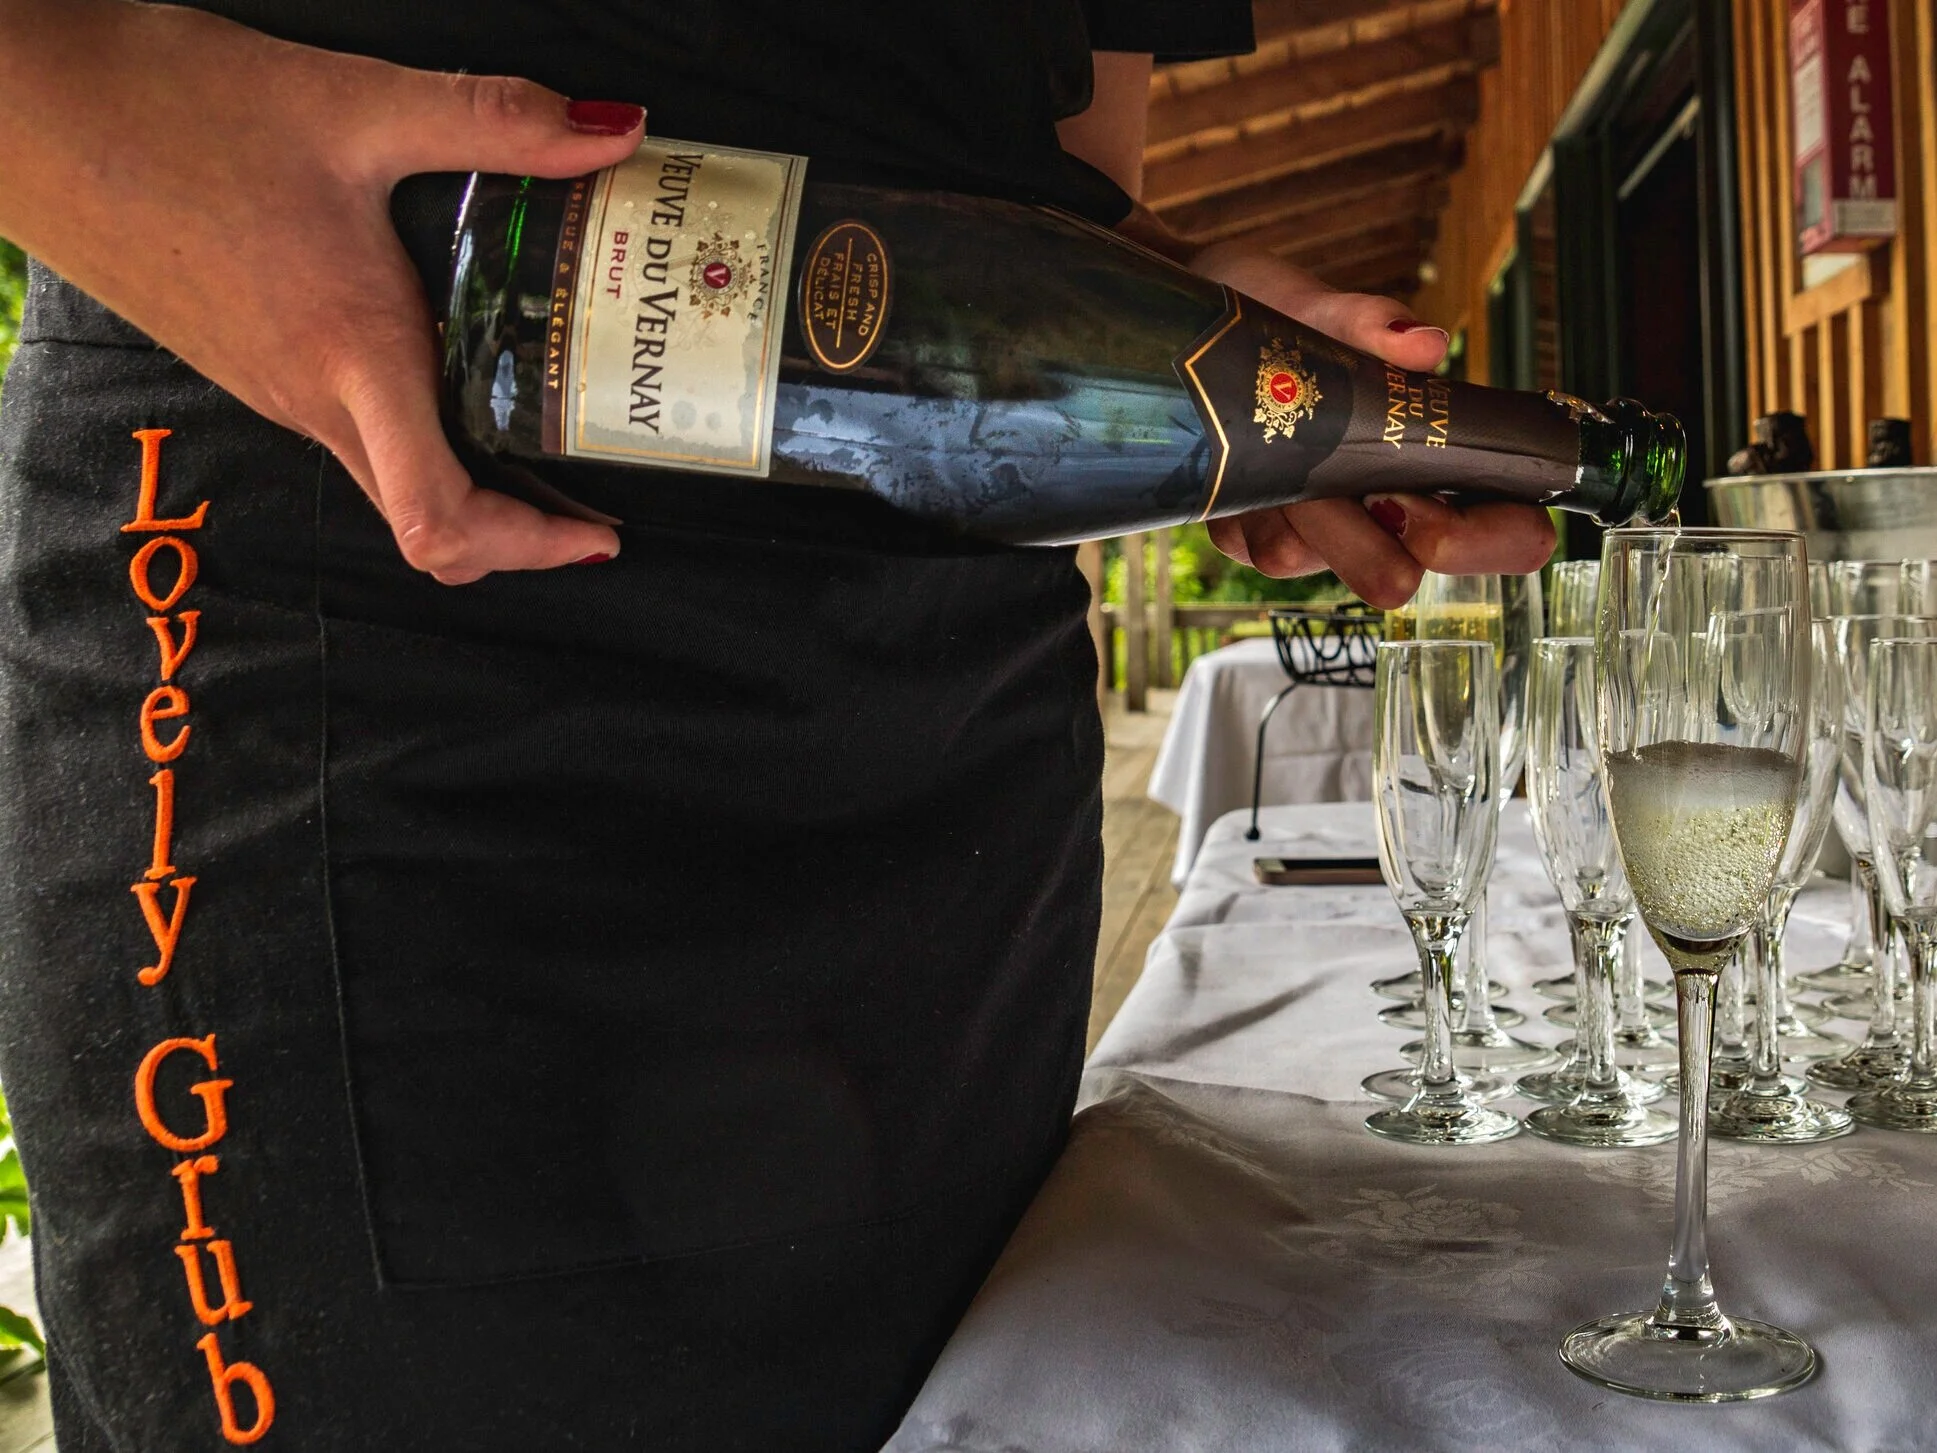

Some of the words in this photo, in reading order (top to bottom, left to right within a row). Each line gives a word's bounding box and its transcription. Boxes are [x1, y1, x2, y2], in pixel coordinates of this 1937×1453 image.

[1847, 0, 1868, 34] E
[1848, 54, 1876, 200] ALARM
[651, 154, 704, 227] VEUVE
[606, 231, 629, 299] BRUT
[643, 236, 672, 285] DU
[747, 244, 769, 320] FRANCE
[813, 257, 831, 320] DÉLICAT
[829, 252, 844, 300] FRAIS
[846, 262, 863, 320] FRESH
[867, 253, 879, 299] CRISP
[548, 287, 569, 389] ÉLÉGANT
[825, 307, 838, 330] ET
[858, 301, 876, 336] AND
[629, 287, 679, 434] VERNAY
[1408, 387, 1424, 418] DU
[1426, 379, 1451, 448] VEUVE
[120, 428, 211, 986] Lovely
[135, 1033, 275, 1445] Grub
